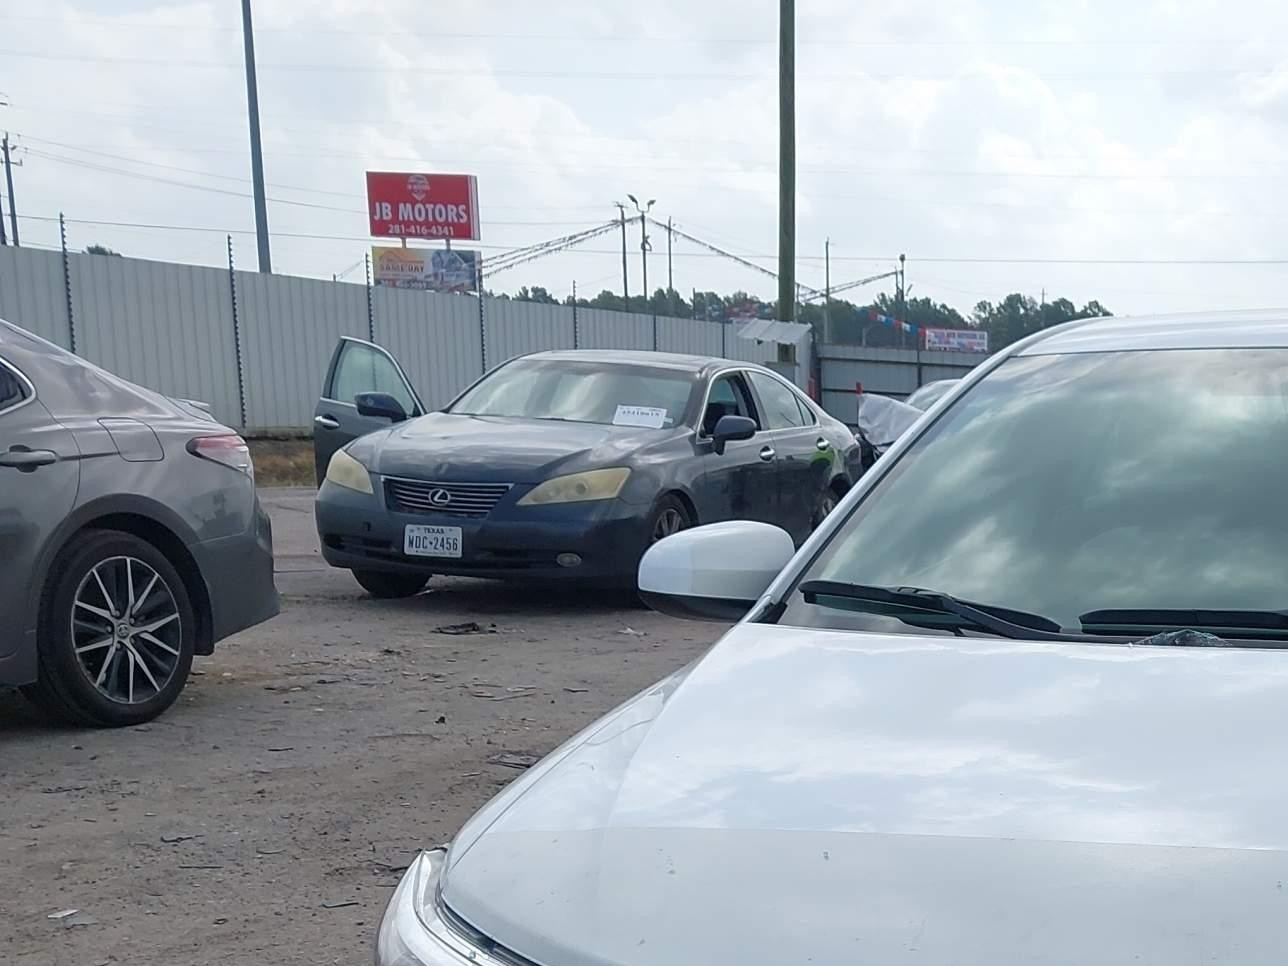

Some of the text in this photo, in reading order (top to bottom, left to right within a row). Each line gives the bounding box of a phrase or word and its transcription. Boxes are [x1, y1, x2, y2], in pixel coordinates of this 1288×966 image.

[374, 202, 467, 223] JB MOTORS
[388, 224, 454, 236] 281-416-4341
